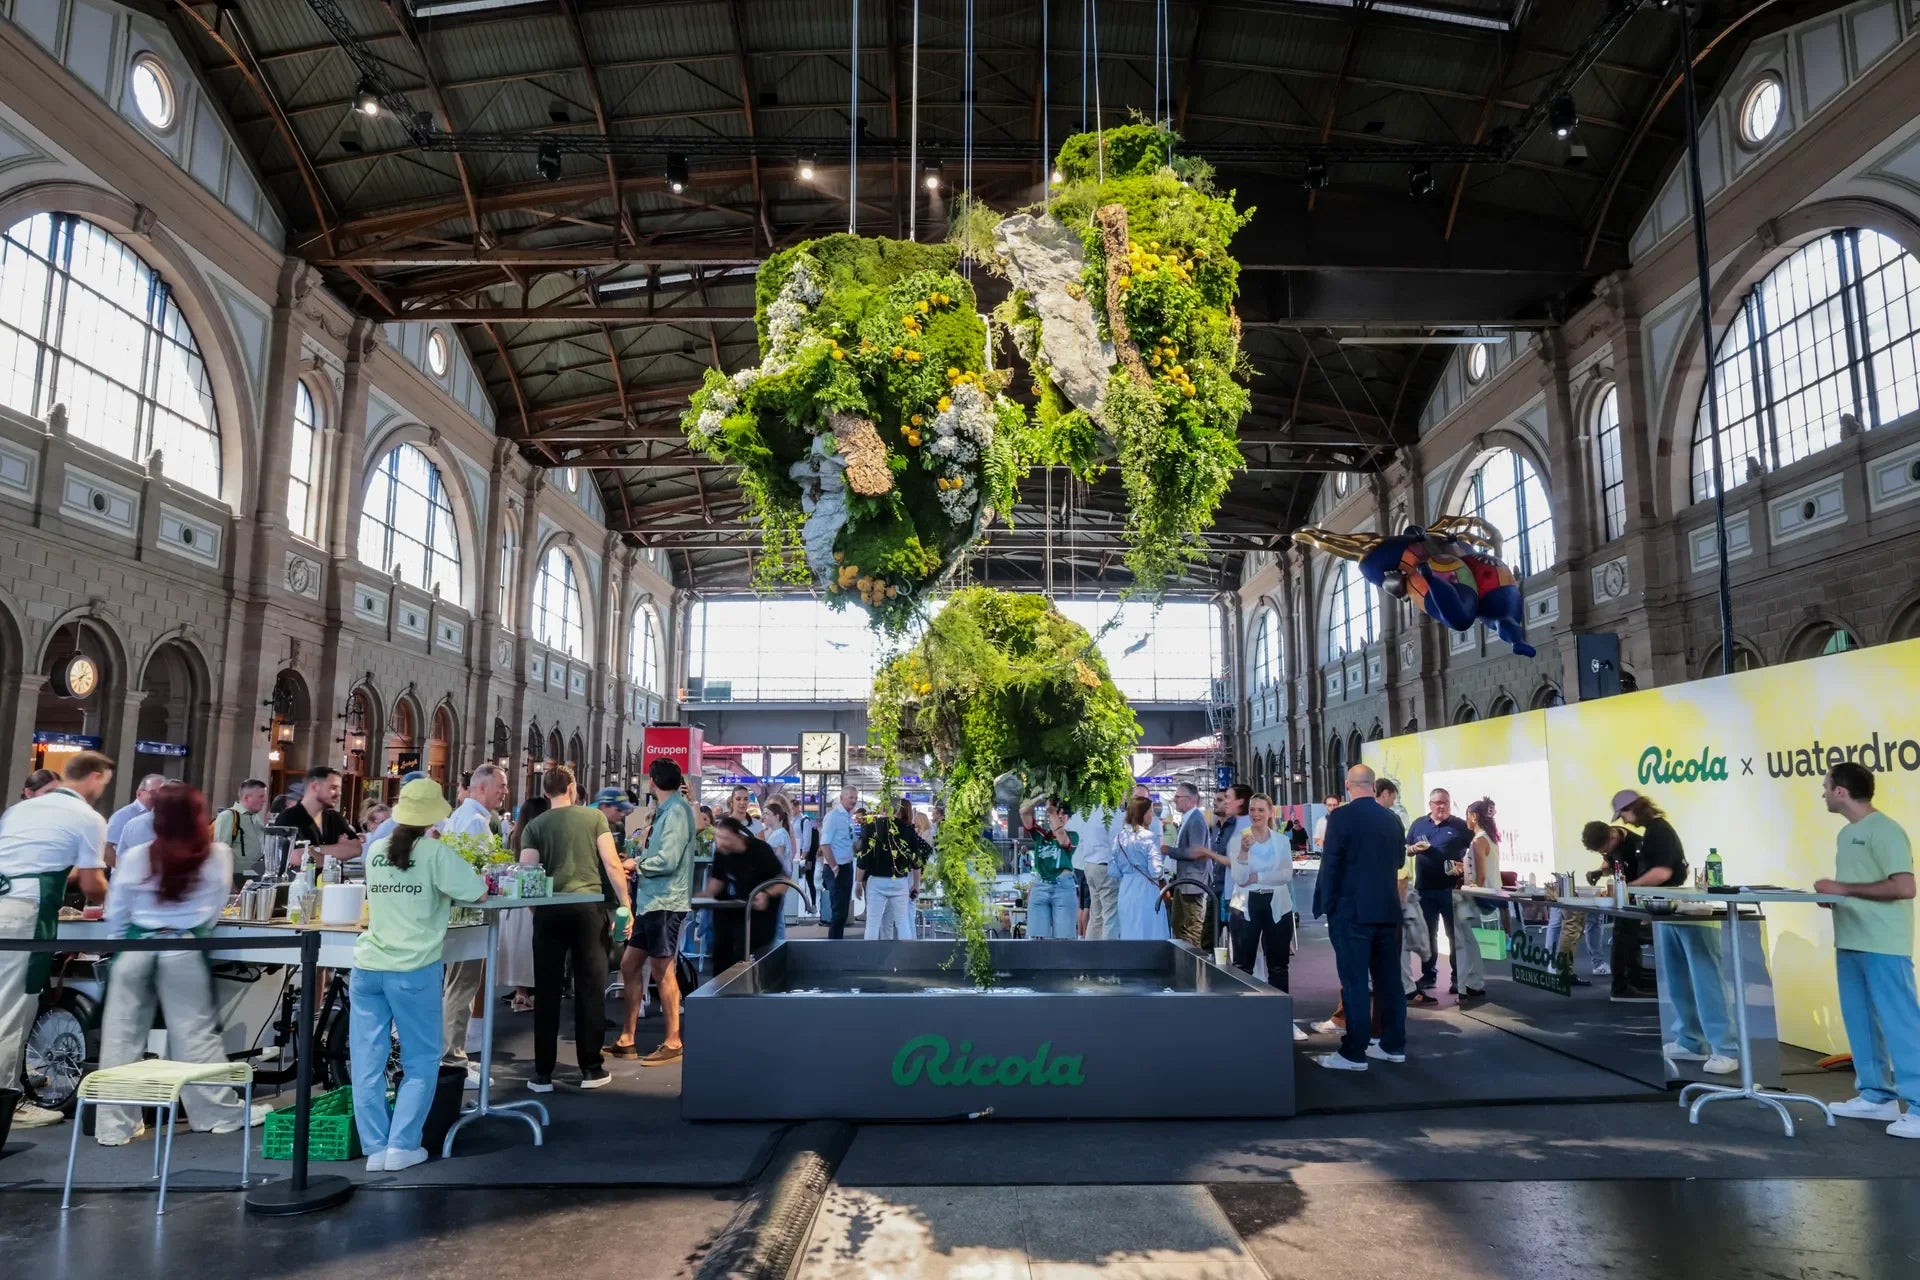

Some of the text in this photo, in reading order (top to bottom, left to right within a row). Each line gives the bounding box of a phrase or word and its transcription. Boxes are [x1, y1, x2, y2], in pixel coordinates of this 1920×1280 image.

[646, 745, 688, 756] Gruppen
[1638, 746, 1728, 785] Ricola
[368, 882, 422, 895] aterdrop
[1511, 929, 1574, 970] Ricola
[891, 1034, 1085, 1086] Ricola
